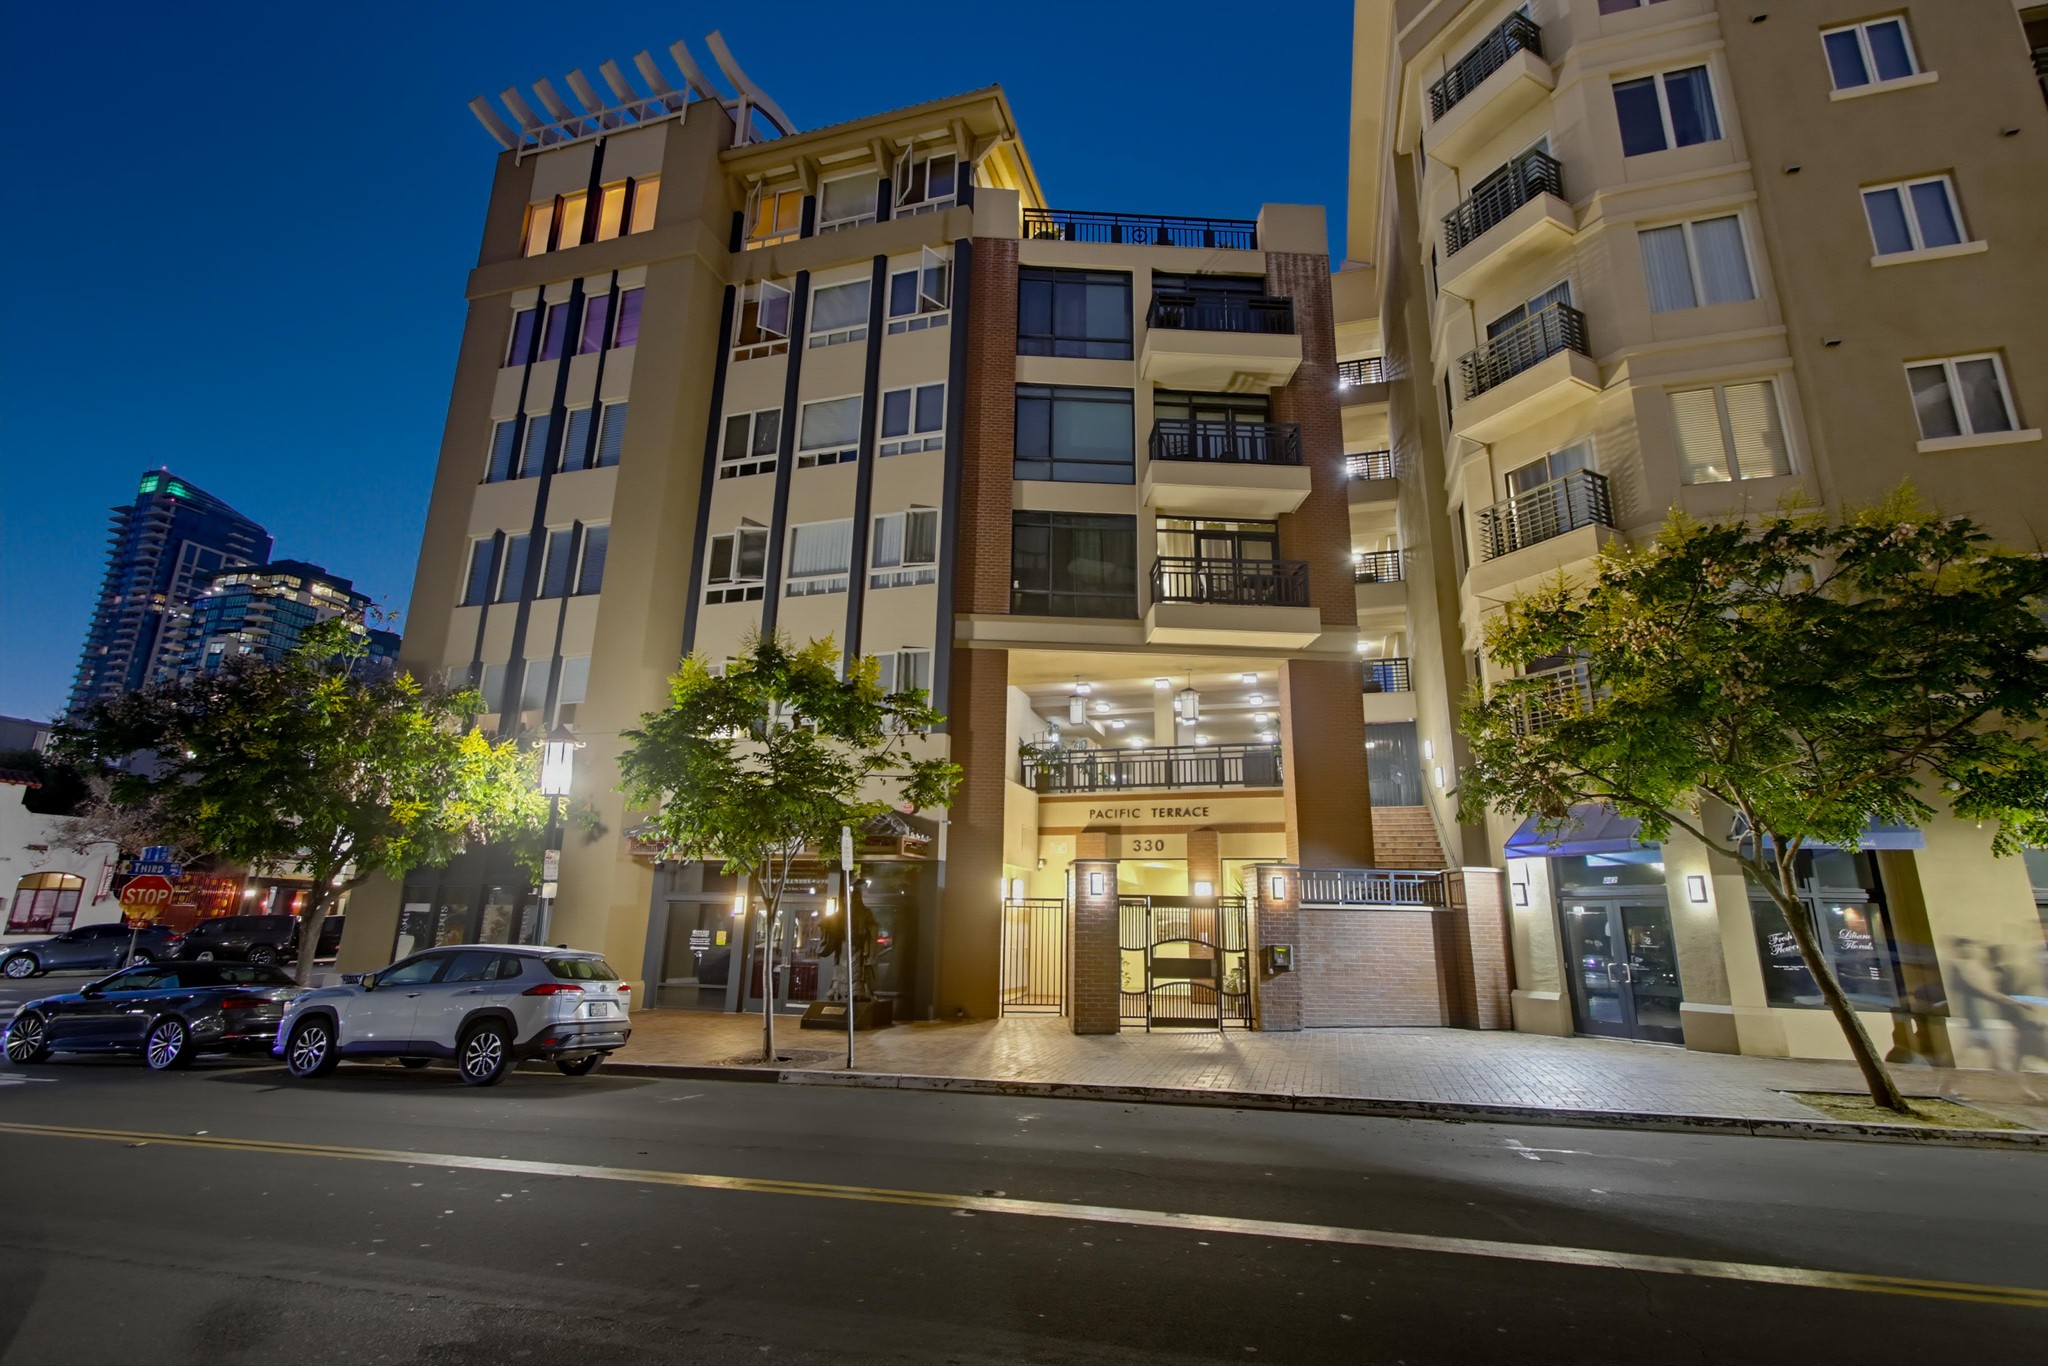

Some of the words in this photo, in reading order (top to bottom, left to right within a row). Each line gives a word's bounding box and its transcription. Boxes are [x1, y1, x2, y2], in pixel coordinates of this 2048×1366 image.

[1089, 808, 1141, 819] PACIFIC
[1150, 806, 1209, 818] TERRACE
[1133, 839, 1165, 852] 330
[134, 862, 164, 874] THIRD
[124, 888, 168, 905] STOP
[1767, 931, 1793, 945] Fresh
